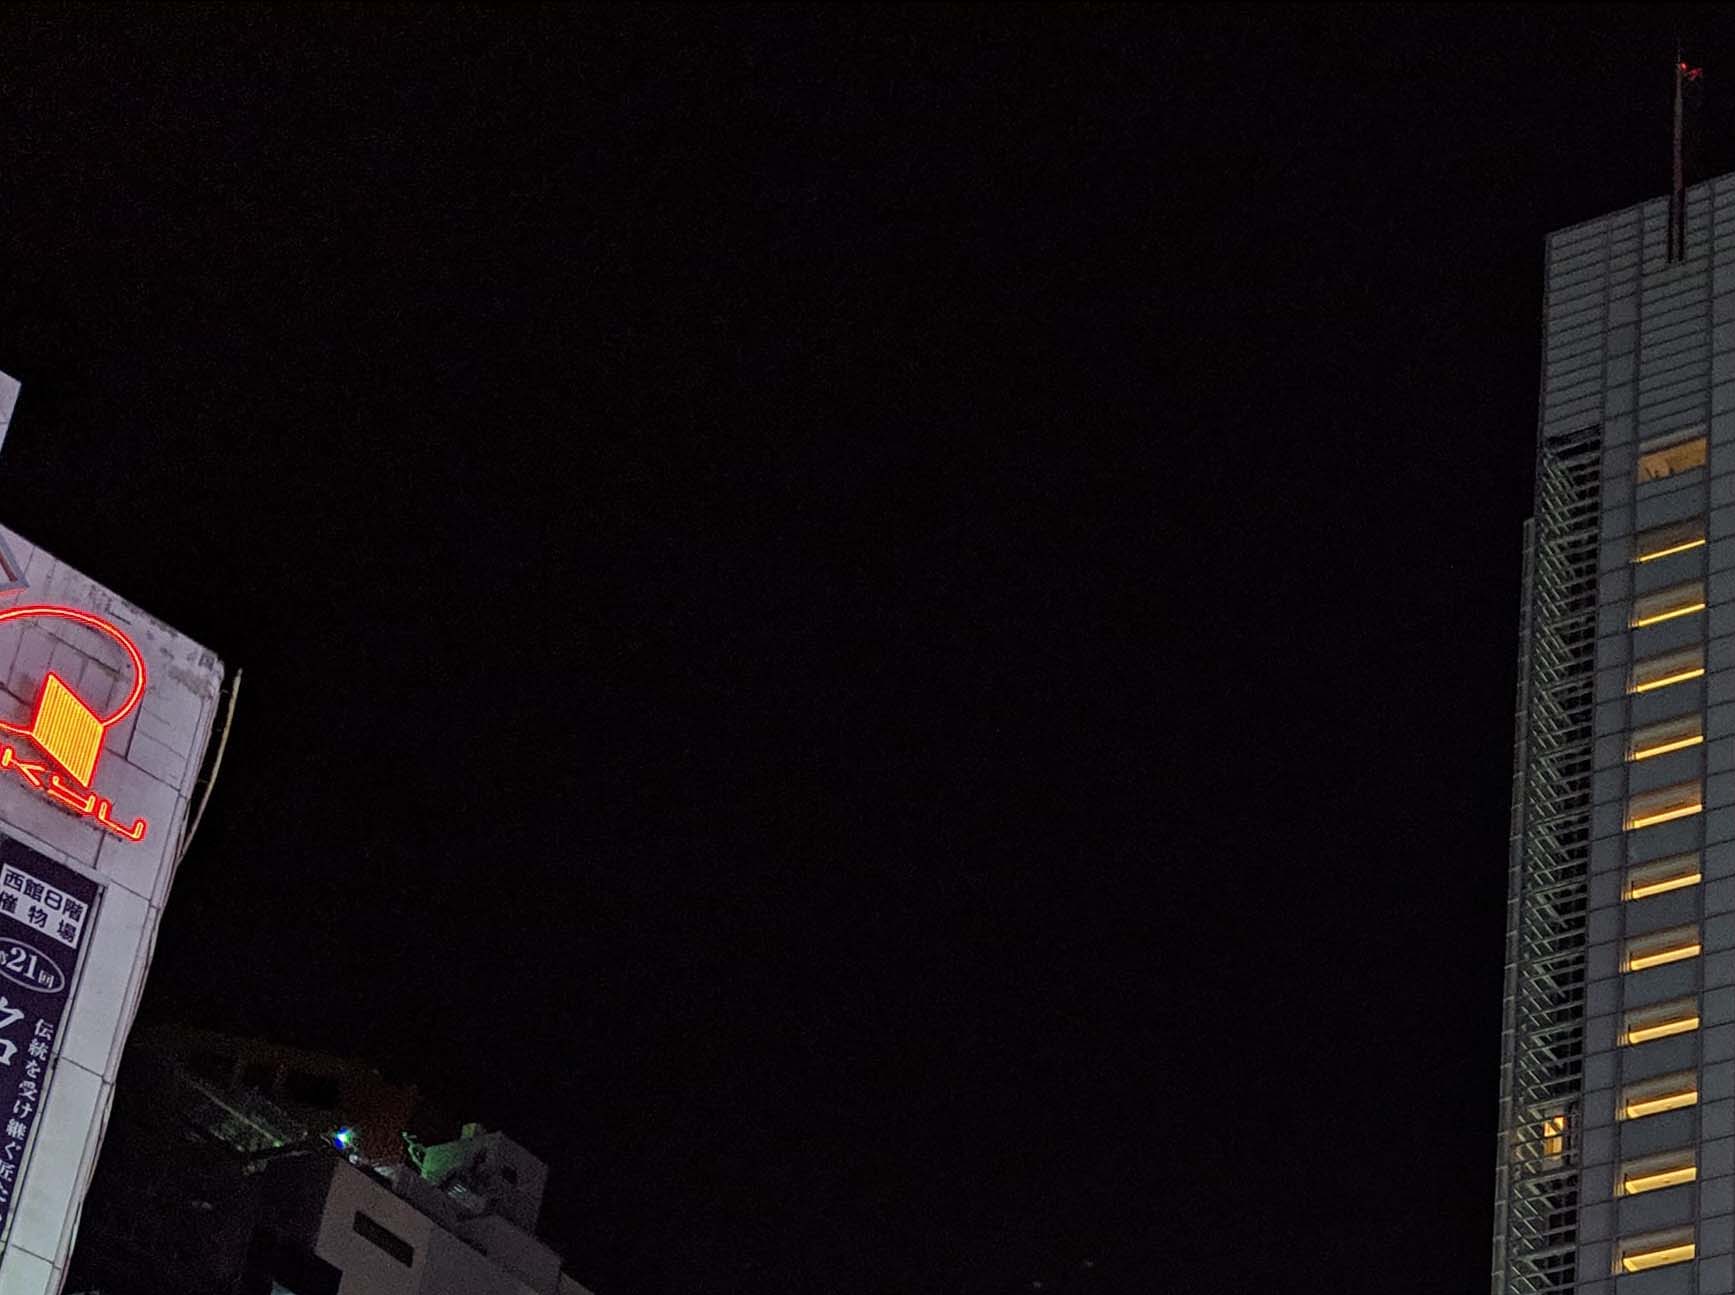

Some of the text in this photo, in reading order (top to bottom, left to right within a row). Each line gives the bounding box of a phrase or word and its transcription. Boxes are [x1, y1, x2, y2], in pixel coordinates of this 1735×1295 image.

[3, 868, 85, 923] 西館8階
[0, 946, 54, 989] 21回
